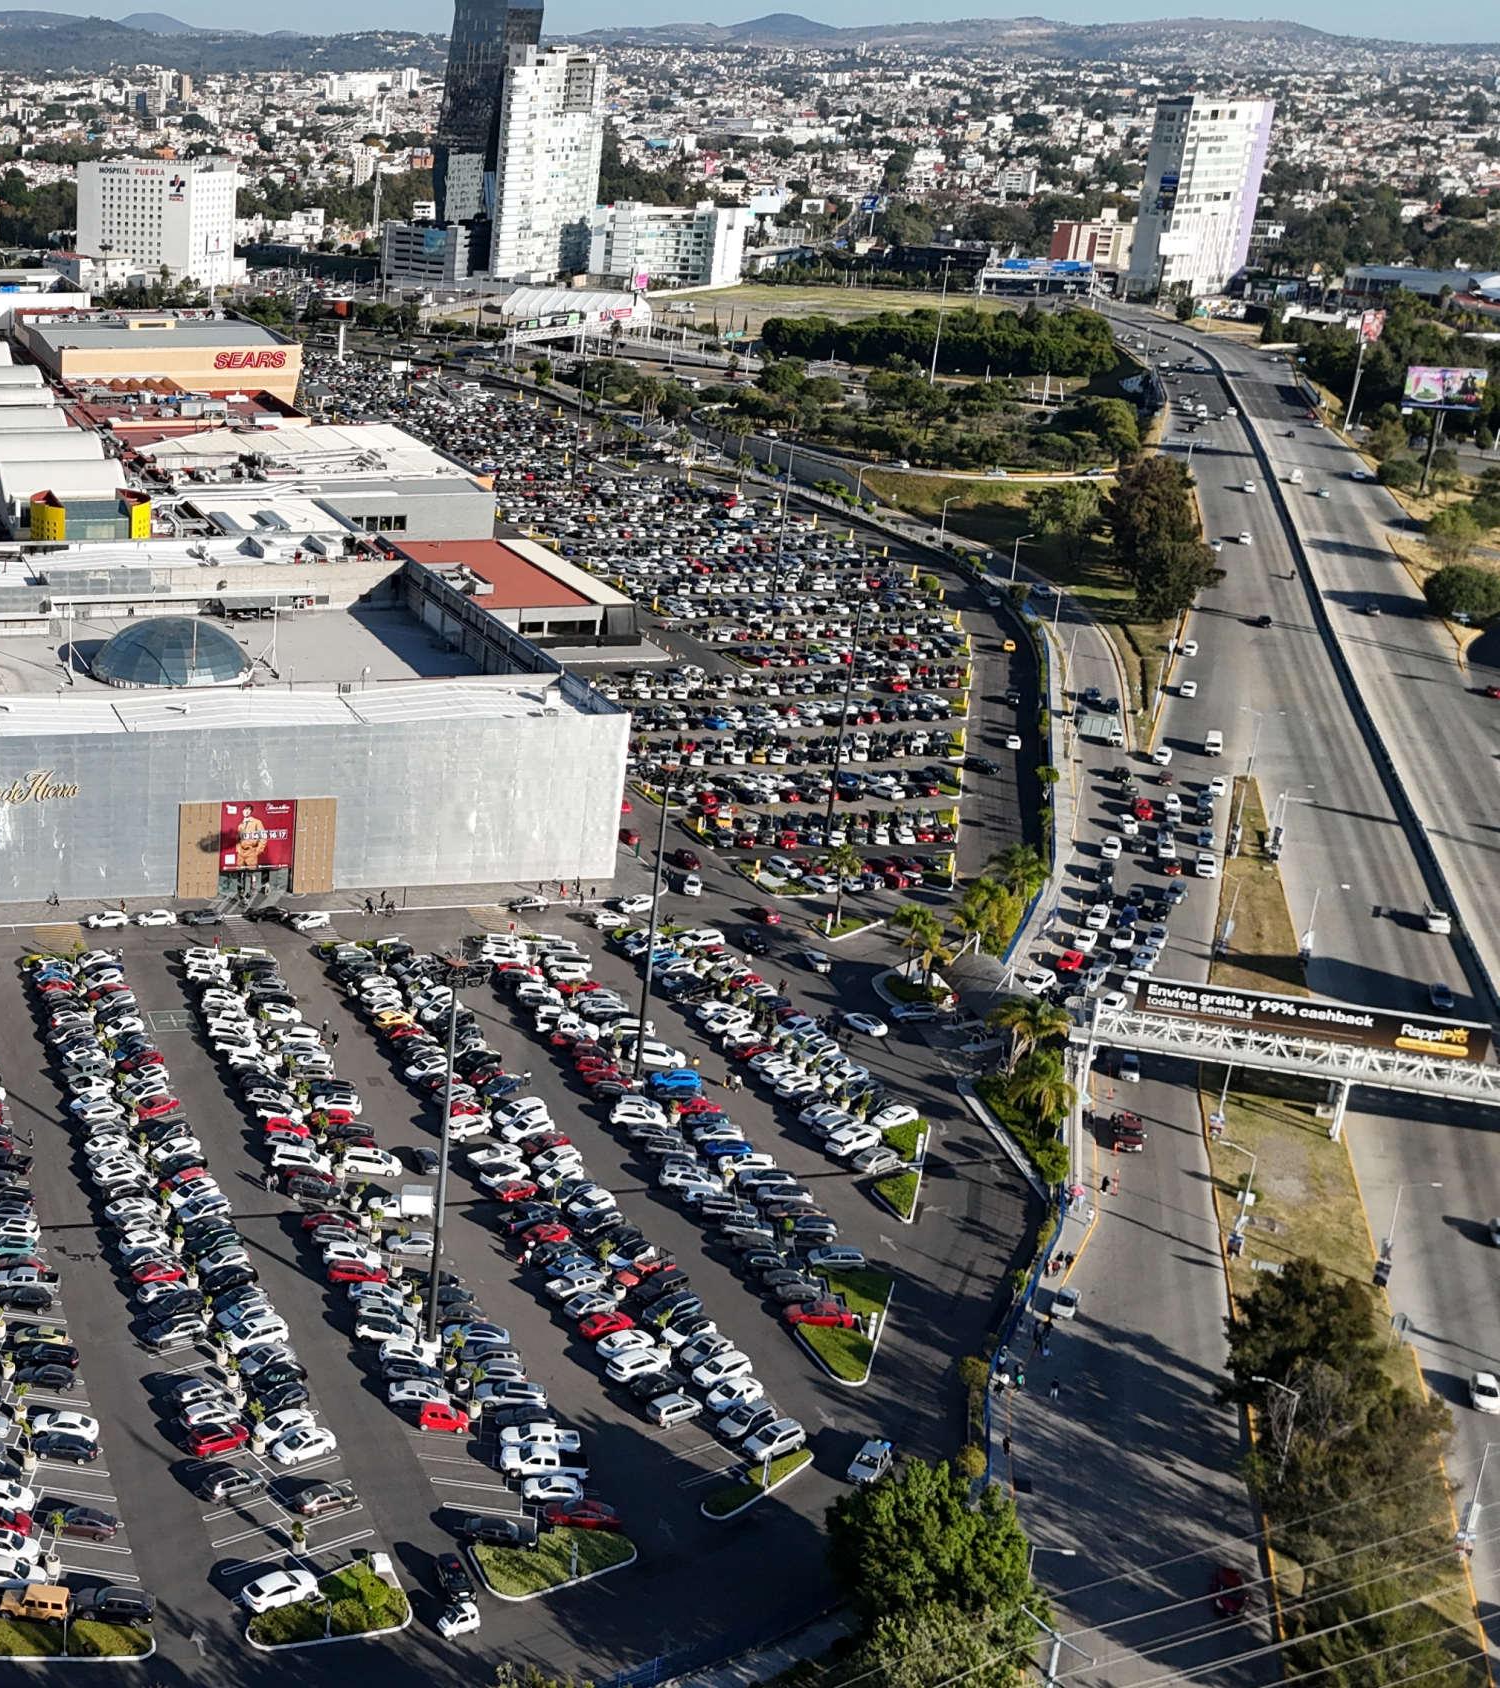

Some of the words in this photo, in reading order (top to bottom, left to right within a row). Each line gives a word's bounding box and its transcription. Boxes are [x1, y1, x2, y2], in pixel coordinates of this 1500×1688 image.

[99, 167, 130, 175] HOSPITAL
[135, 168, 165, 176] PUEBLA
[213, 351, 287, 370] SEARS
[1147, 984, 1197, 1001] Envíos
[1200, 993, 1245, 1009] gratis
[1246, 1001, 1257, 1012] y
[1260, 1000, 1297, 1016] 99%
[1299, 1008, 1375, 1028] cashback
[1147, 996, 1180, 1009] todas
[1182, 1001, 1199, 1012] las
[1200, 1005, 1253, 1020] semanas
[1401, 1023, 1470, 1044] RappiPro
